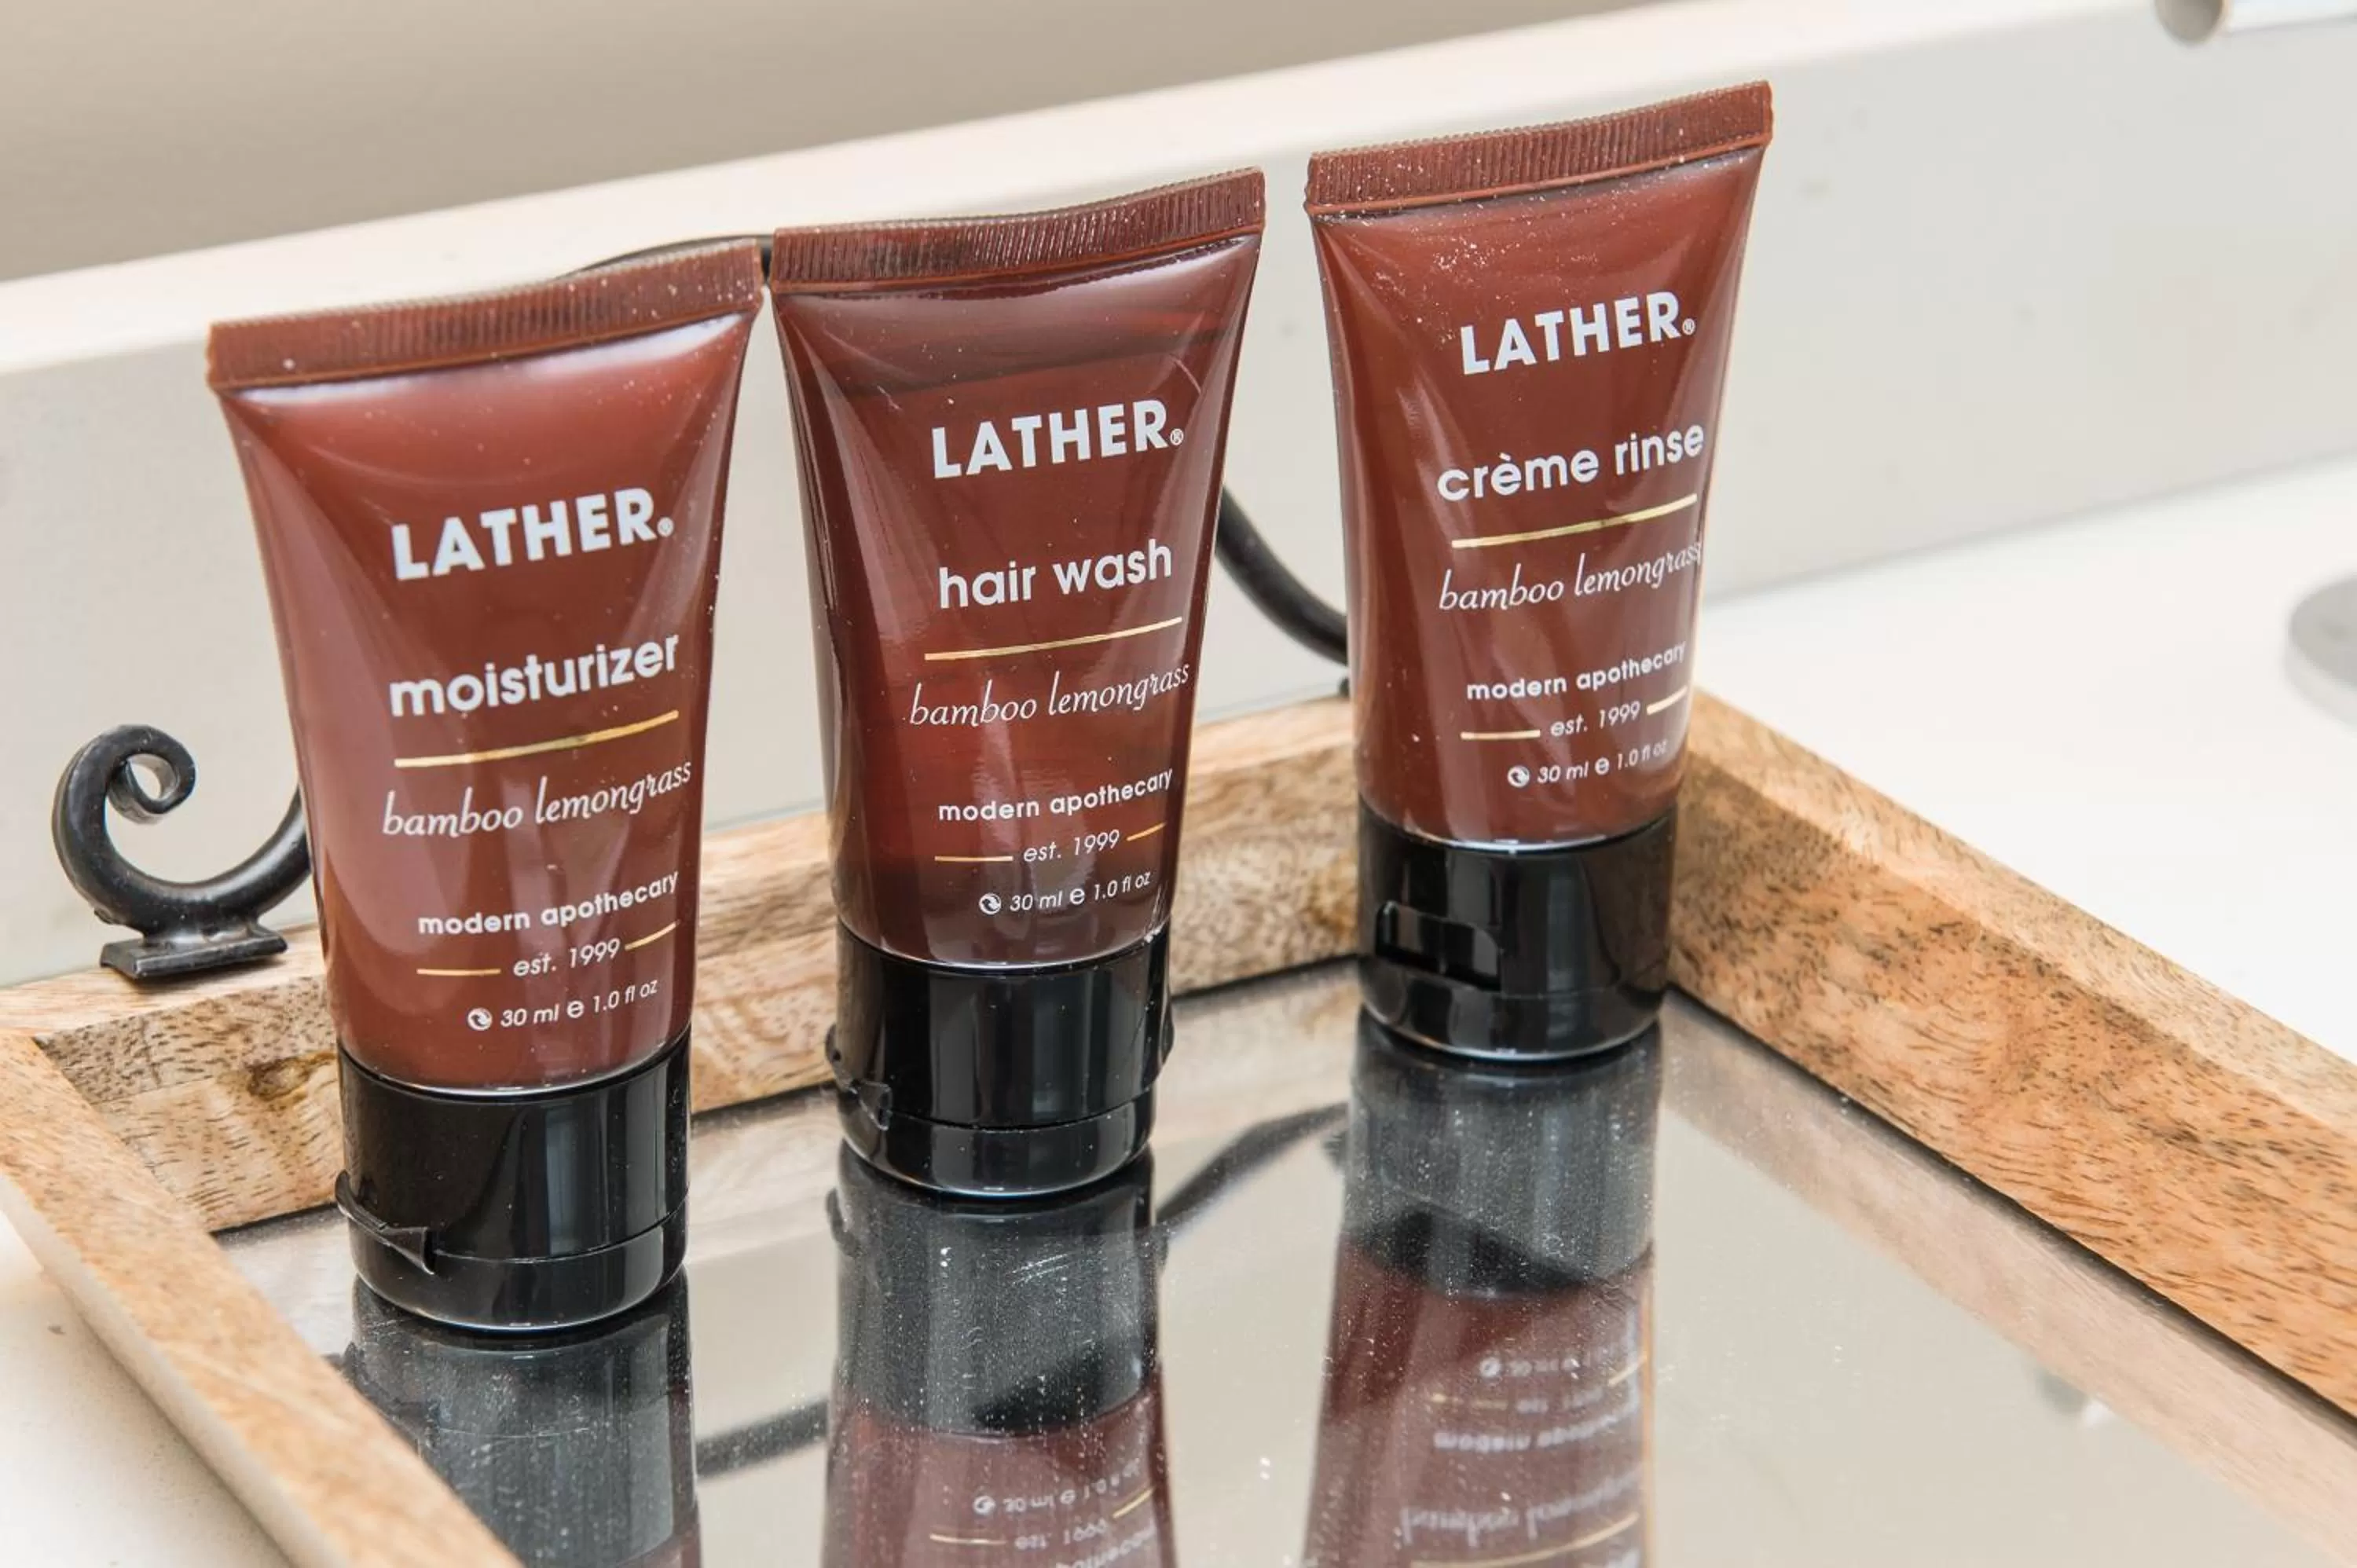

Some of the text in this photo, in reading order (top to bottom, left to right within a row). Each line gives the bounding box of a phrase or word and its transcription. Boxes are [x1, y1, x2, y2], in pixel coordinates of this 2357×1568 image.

[1437, 424, 1705, 501] crème rinse
[939, 538, 1171, 609] hair wash
[1439, 562, 1565, 610] bamboo
[390, 635, 679, 716] moisturizer
[909, 664, 1189, 727] bamboo lemongrass
[1467, 641, 1687, 701] modern apothecary
[1550, 701, 1640, 737] est. 1999
[1537, 765, 1561, 784] 30
[1566, 761, 1589, 780] ml
[1617, 749, 1638, 770] 1.0
[382, 760, 691, 837] bamboo lemongrass
[938, 768, 1173, 821] modern apothecary
[1023, 830, 1120, 863] est. 1999
[418, 871, 678, 935] modern apothecary
[1010, 893, 1033, 913] 30
[1039, 889, 1062, 908] ml
[1094, 880, 1118, 901] 1.0
[1121, 875, 1131, 892] fl
[1135, 870, 1152, 888] oz
[513, 938, 620, 977] est. 1999
[500, 1008, 527, 1028] 30
[533, 1004, 559, 1024] ml
[592, 989, 619, 1013] 1.0
[624, 984, 635, 1004] fl
[640, 978, 658, 998] oz
